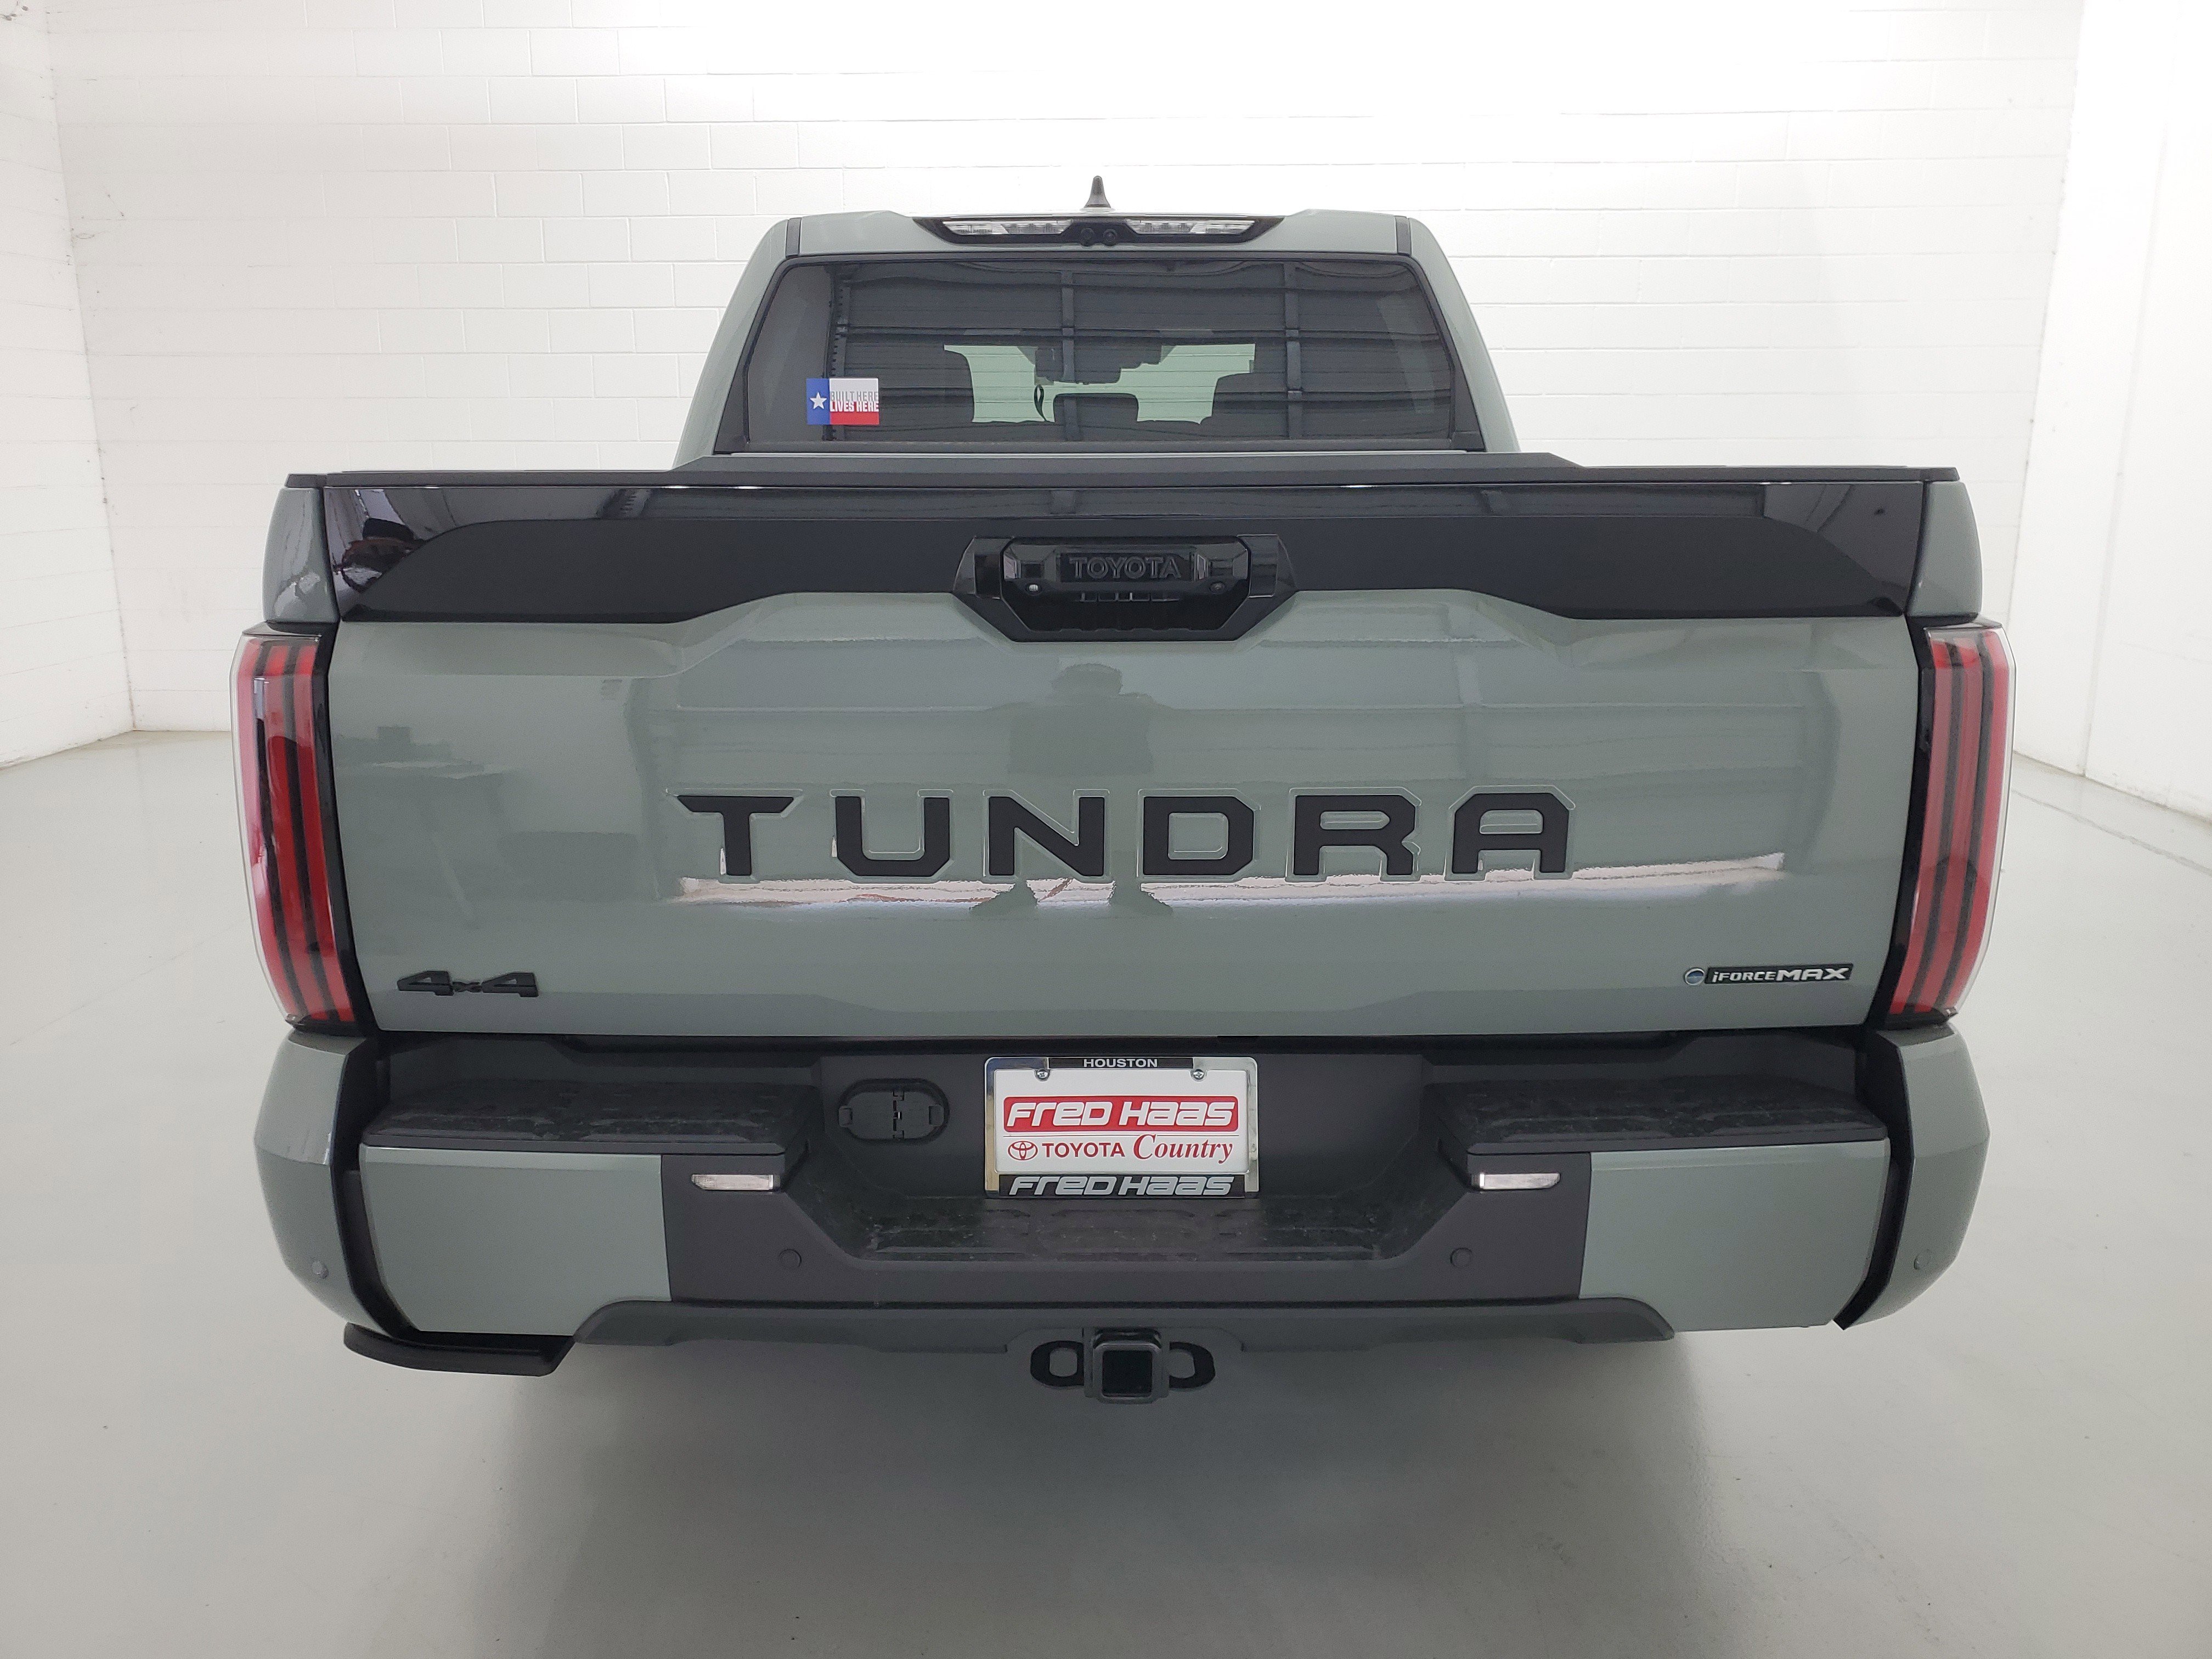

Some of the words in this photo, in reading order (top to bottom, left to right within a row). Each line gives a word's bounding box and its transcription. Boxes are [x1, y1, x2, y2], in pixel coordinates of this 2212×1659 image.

[830, 391, 855, 401] BUILT
[856, 391, 879, 401] HERE
[830, 401, 854, 411] LIVES
[856, 401, 879, 411] HERE
[1069, 556, 1181, 579] TOYOTA
[675, 793, 1570, 878] TUNDRA
[1083, 1058, 1158, 1068] HOUSTON
[1042, 1142, 1125, 1158] TOYOTA
[1133, 1133, 1233, 1164] Country
